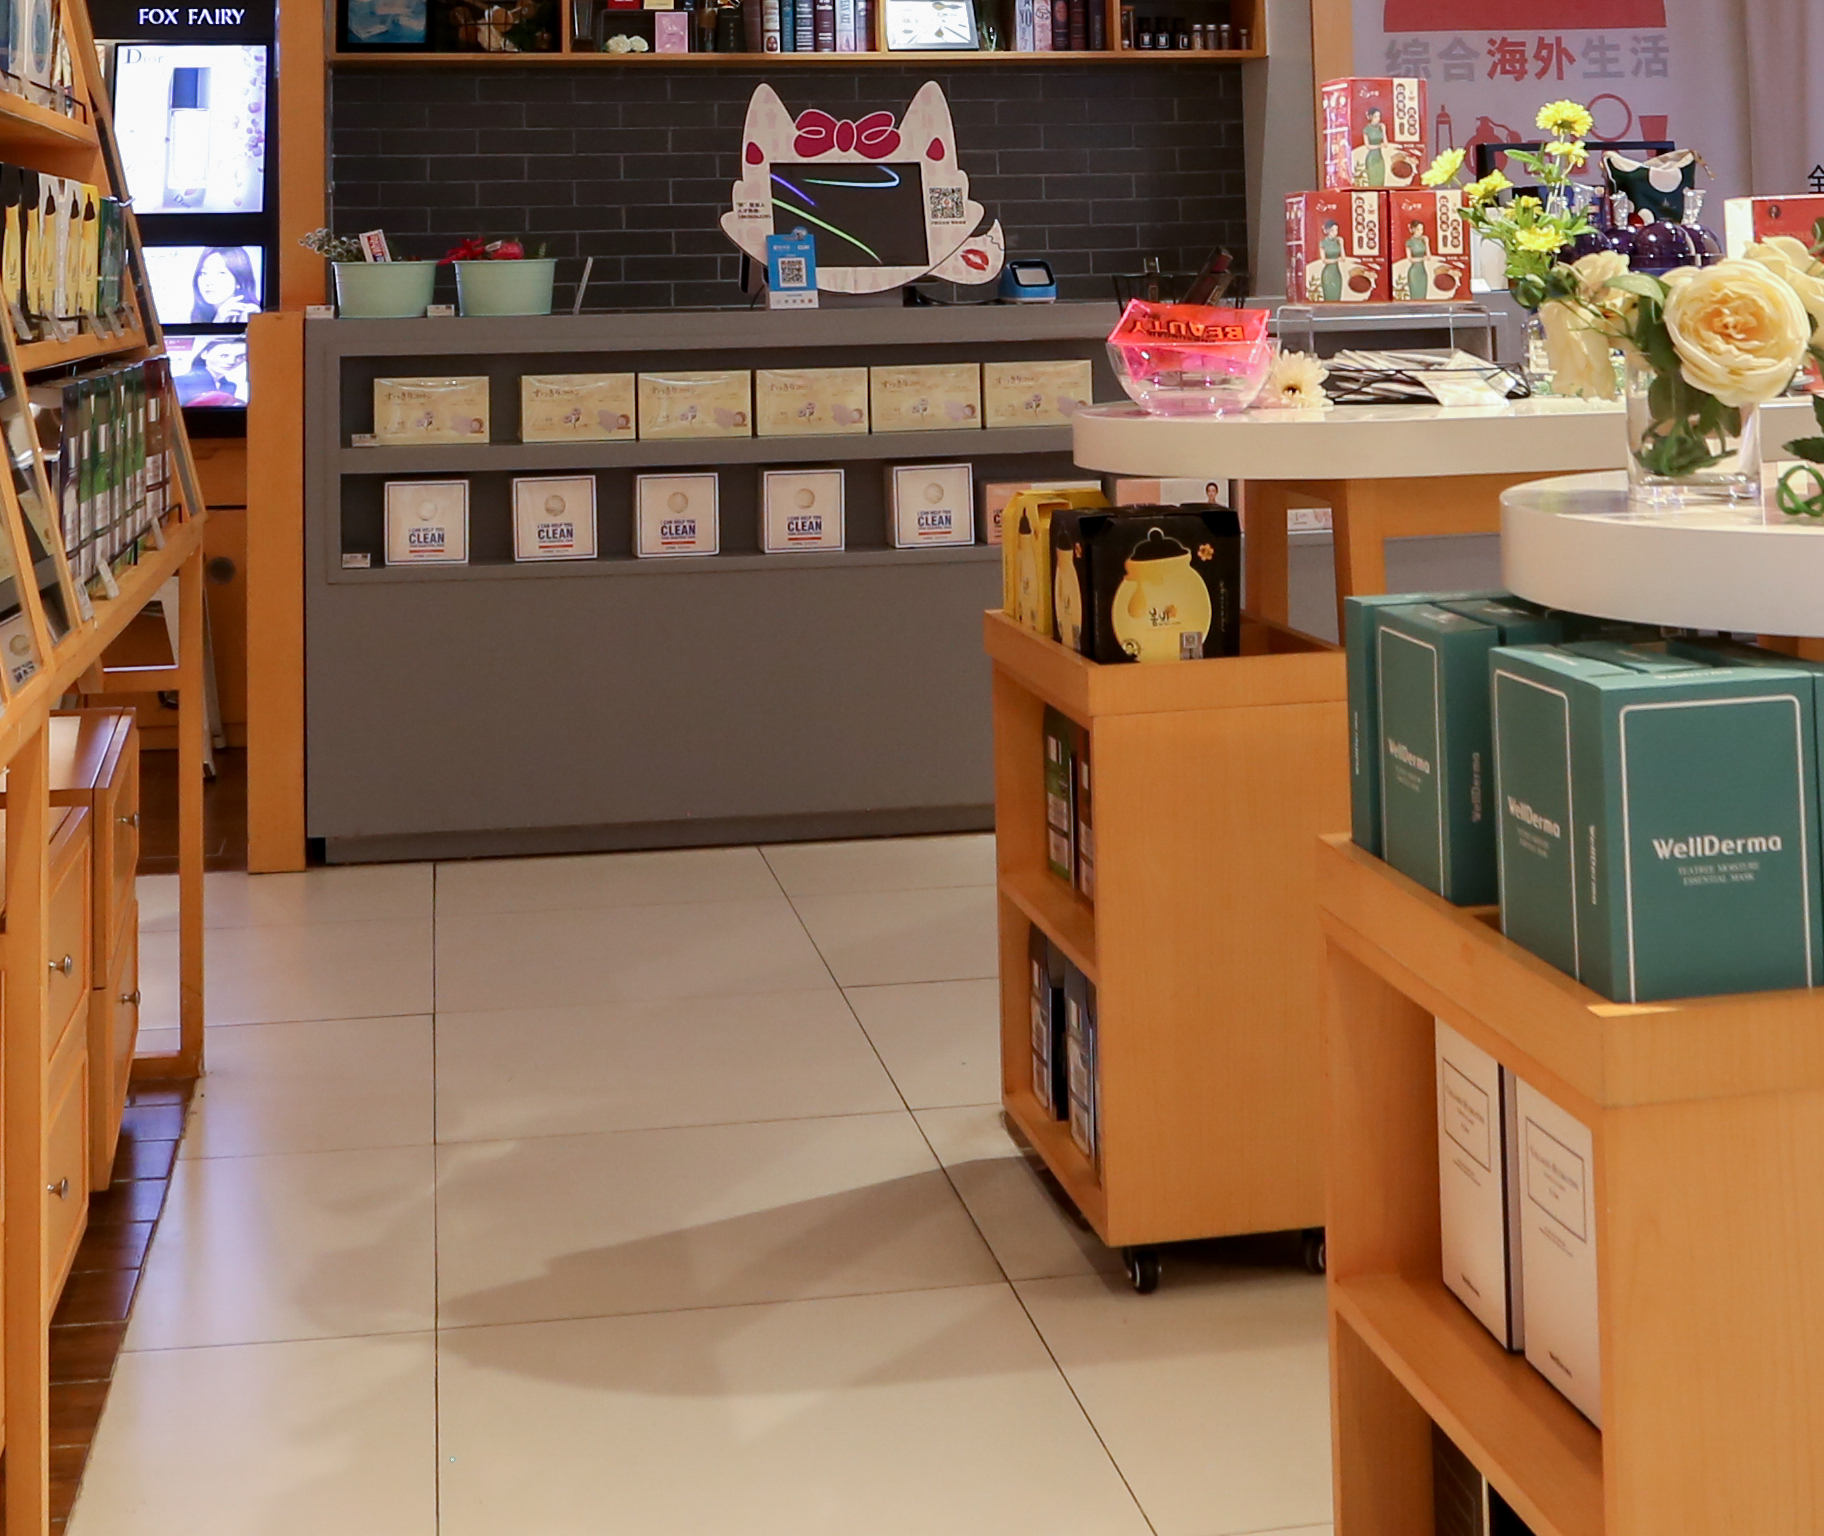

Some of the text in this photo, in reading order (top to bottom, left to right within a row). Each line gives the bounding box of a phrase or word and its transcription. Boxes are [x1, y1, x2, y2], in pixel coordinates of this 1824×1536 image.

[138, 8, 245, 25] FOX FAIRY
[126, 48, 164, 64] Dior
[1384, 35, 1670, 84] 综合海外生活
[1130, 320, 1245, 341] BEAUTY
[787, 520, 822, 532] CLEAN
[918, 515, 952, 527] CLEAN
[537, 528, 573, 540] CLEAN
[660, 524, 696, 536] CLEAN
[409, 533, 444, 544] CLEAN
[1387, 737, 1430, 774] WellDerma
[1507, 794, 1561, 839] WellDerma
[1652, 834, 1782, 860] WellDerma
[1678, 861, 1760, 876] TEATREE MOISTURE
[1683, 871, 1755, 886] ESSENTIAL MASK
